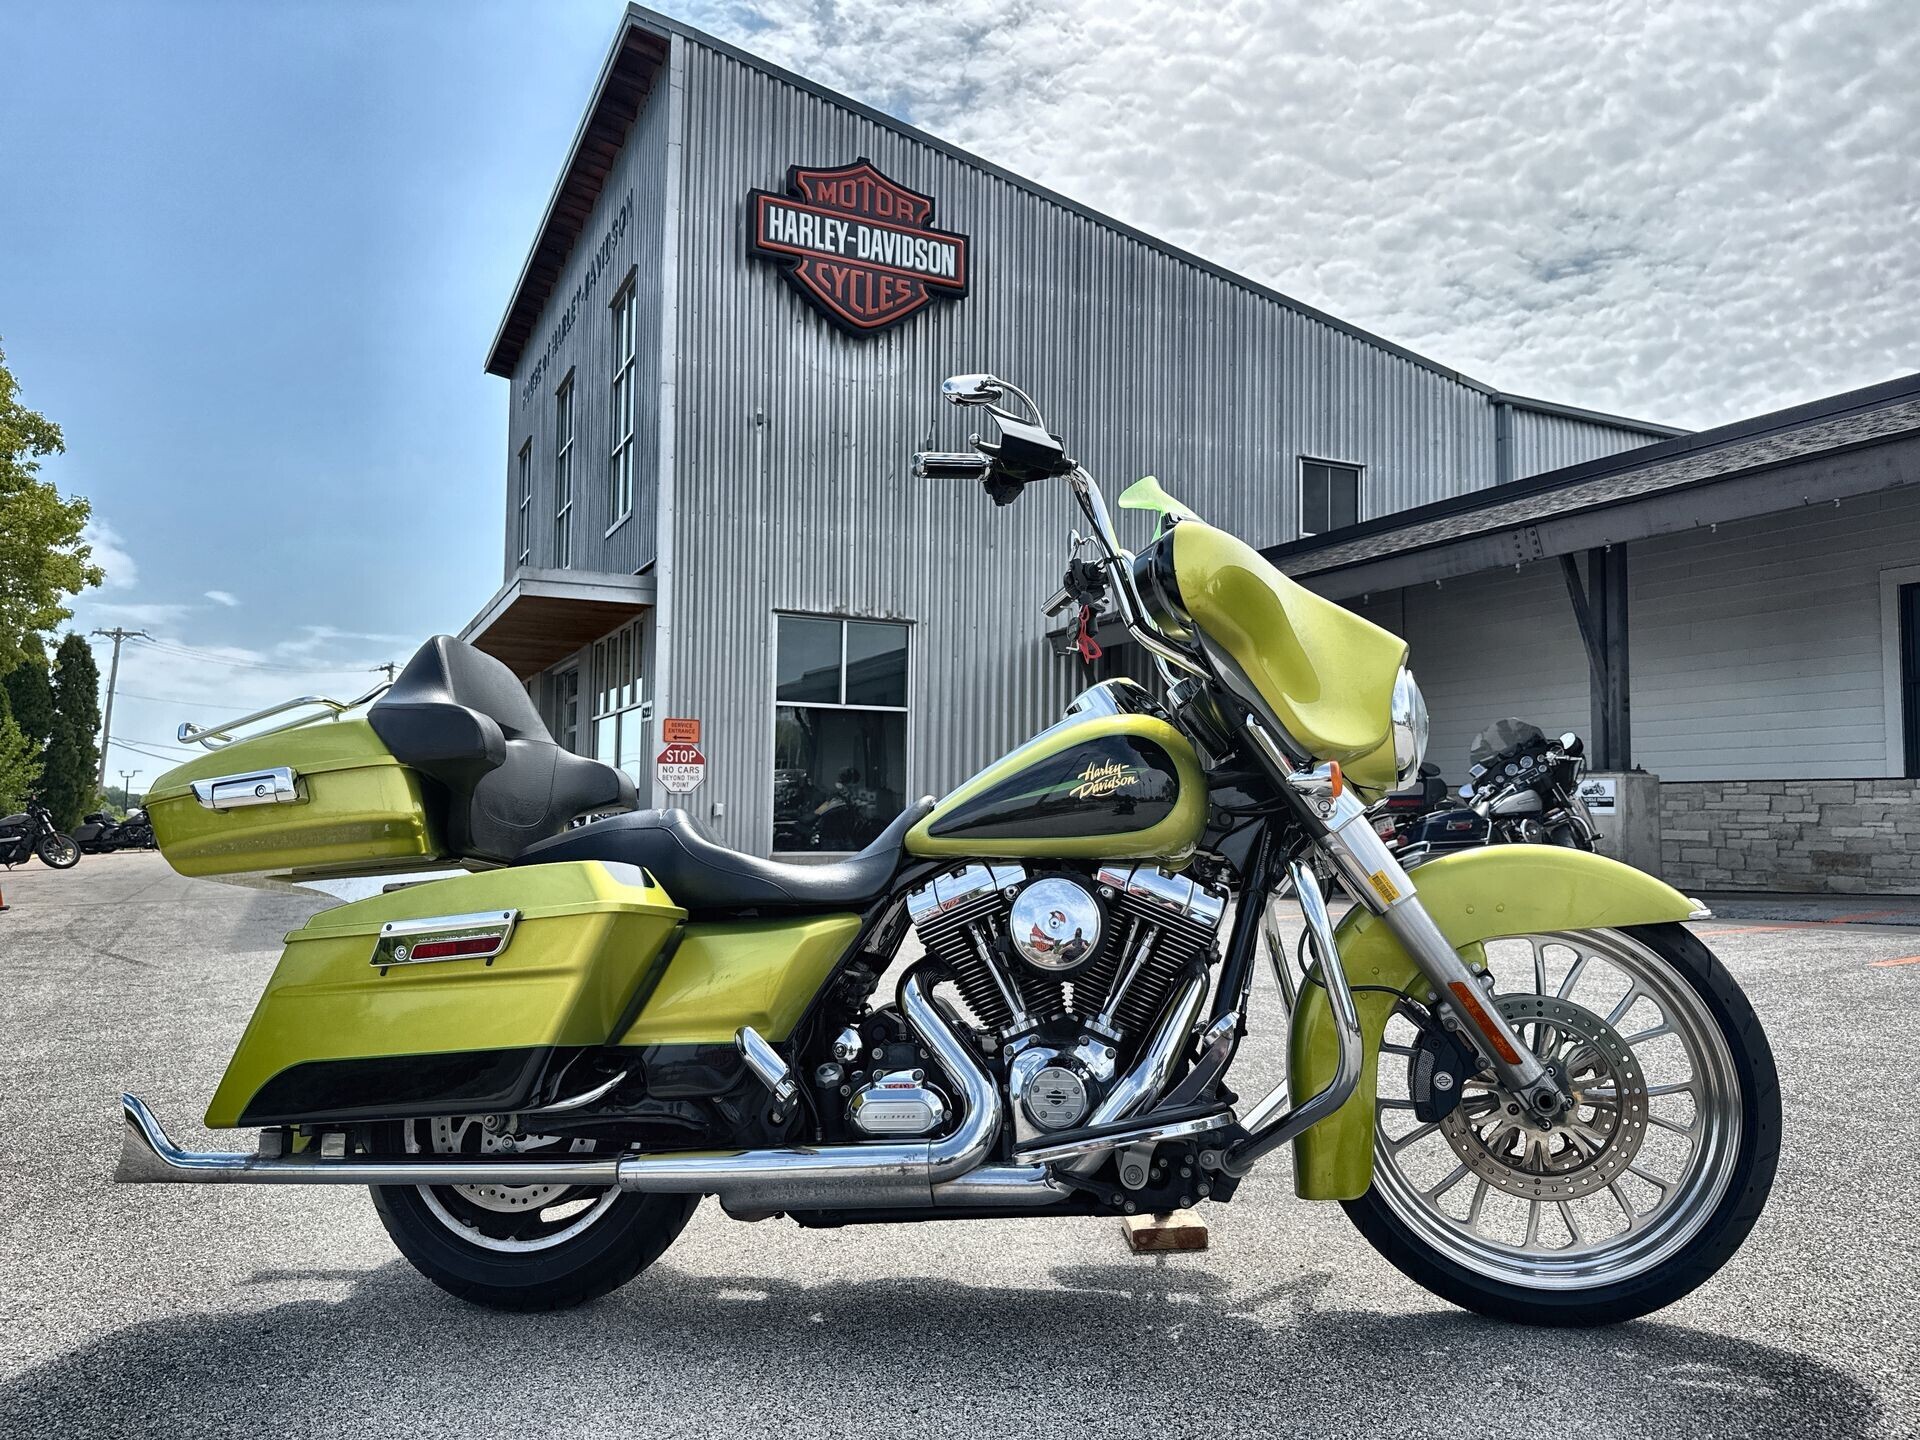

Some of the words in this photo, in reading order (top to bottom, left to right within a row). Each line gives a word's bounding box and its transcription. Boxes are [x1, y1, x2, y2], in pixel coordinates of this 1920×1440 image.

[816, 176, 914, 223] MOTOR
[769, 206, 956, 277] HARLEY-DAVIDSON
[815, 262, 913, 315] CYCLES
[662, 766, 675, 774] NO
[677, 766, 700, 774] CARS
[666, 749, 697, 763] STOP
[1069, 774, 1140, 800] Davidson
